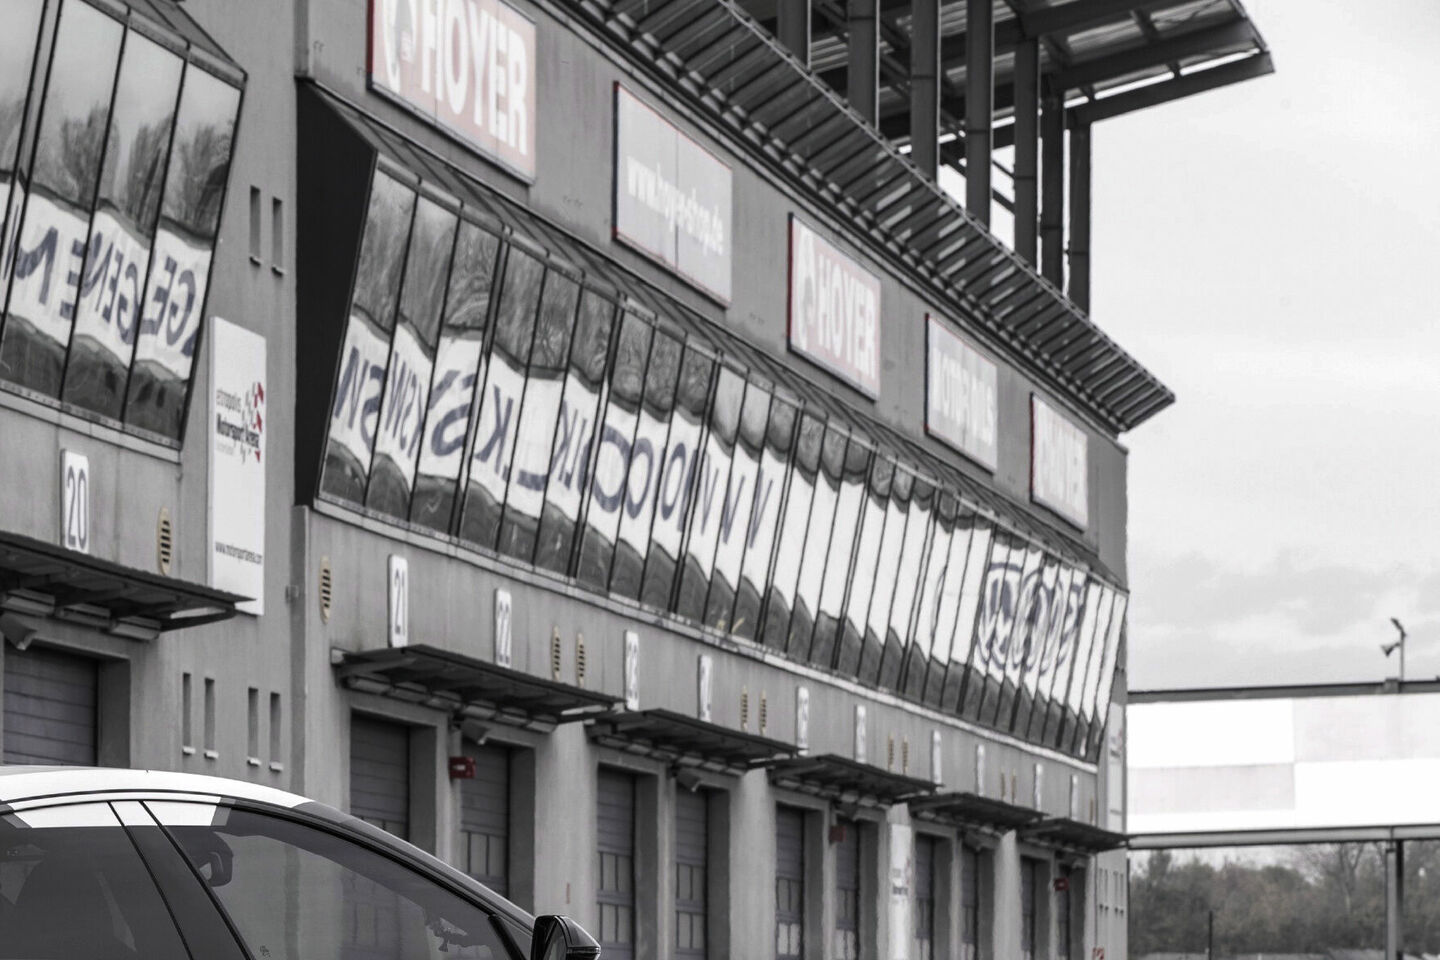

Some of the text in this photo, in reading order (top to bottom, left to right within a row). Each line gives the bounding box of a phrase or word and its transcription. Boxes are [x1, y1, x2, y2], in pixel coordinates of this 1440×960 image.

[421, 0, 528, 155] HOYER
[66, 465, 87, 550] 20
[394, 567, 407, 637] 21
